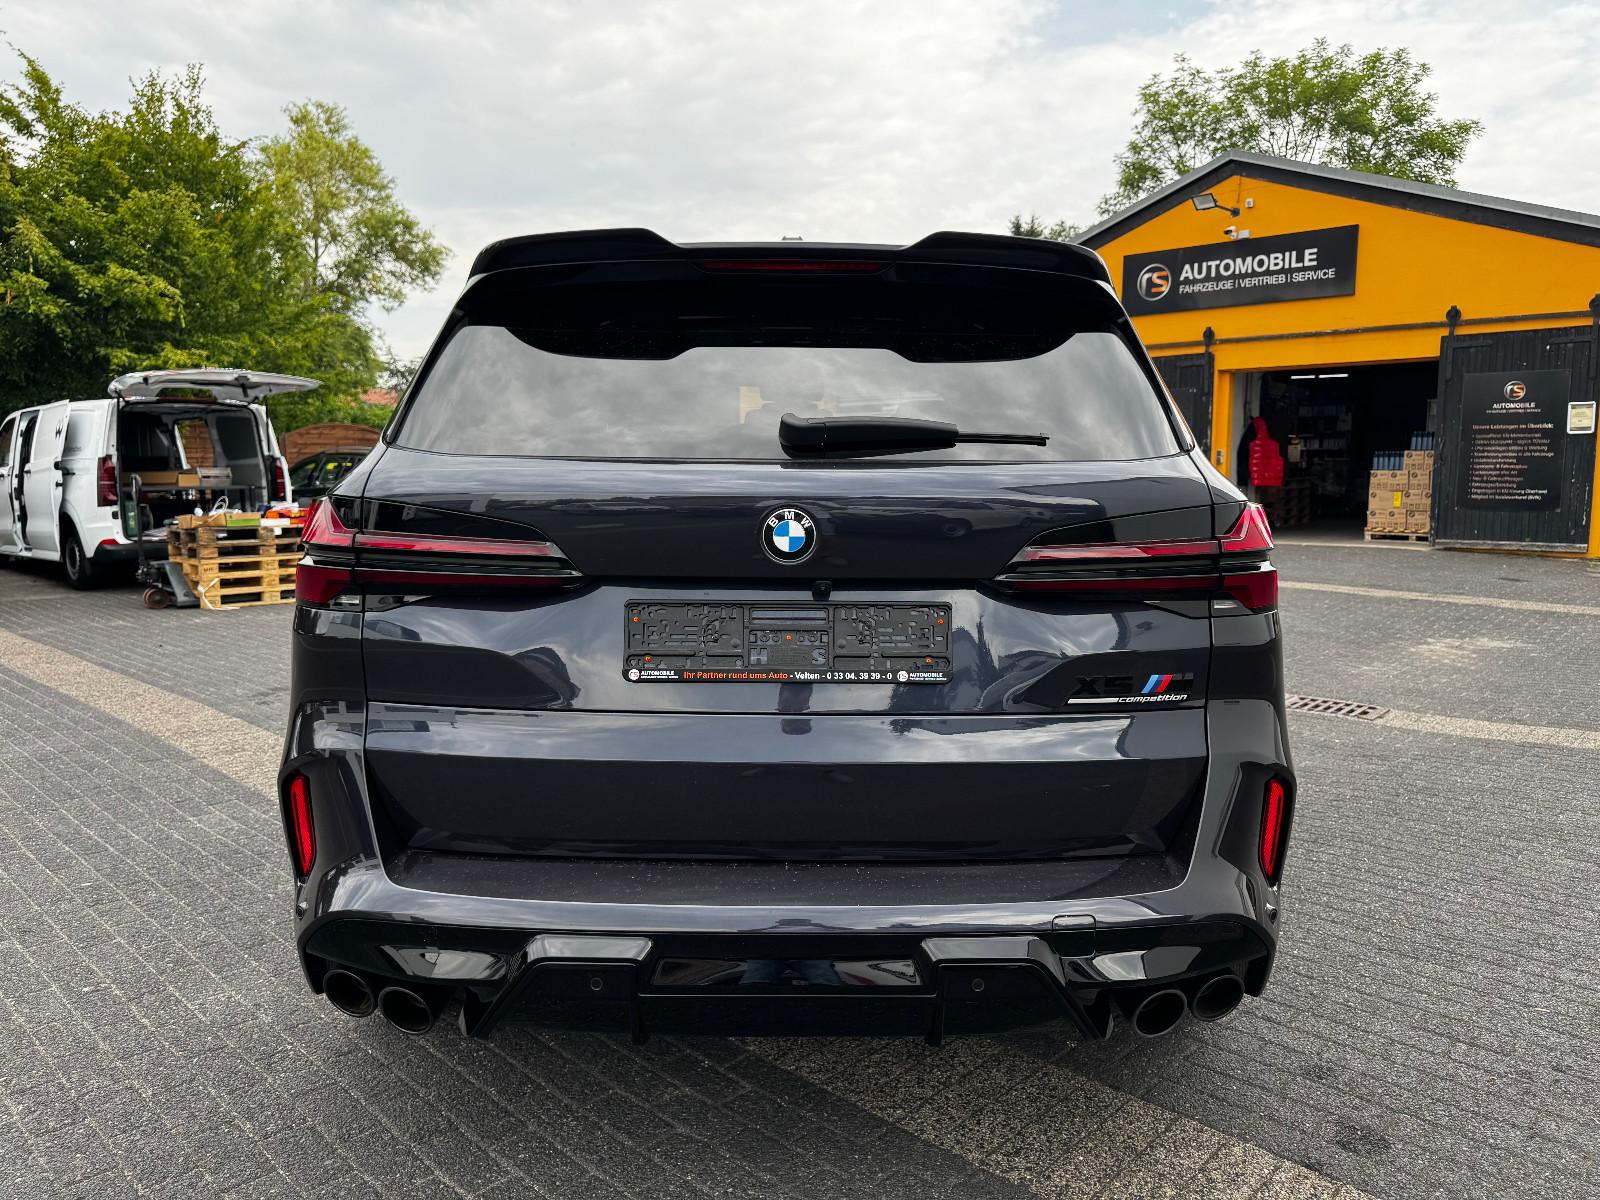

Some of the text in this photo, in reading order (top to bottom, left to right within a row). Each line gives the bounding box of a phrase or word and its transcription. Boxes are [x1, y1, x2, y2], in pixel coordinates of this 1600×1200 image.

[1179, 248, 1318, 281] AUTOMOBILE
[1179, 279, 1235, 295] FAHRZEUGE
[1239, 274, 1286, 290] VERTRIEB
[1292, 268, 1336, 283] SERVICE
[768, 511, 811, 529] BMW
[683, 671, 695, 679] Ihr
[697, 671, 727, 679] Partner
[728, 671, 748, 679] rund
[768, 671, 788, 679] Auto
[794, 671, 820, 680] Velten
[834, 671, 844, 680] 33
[870, 671, 880, 680] 39
[1118, 694, 1188, 704] competition
